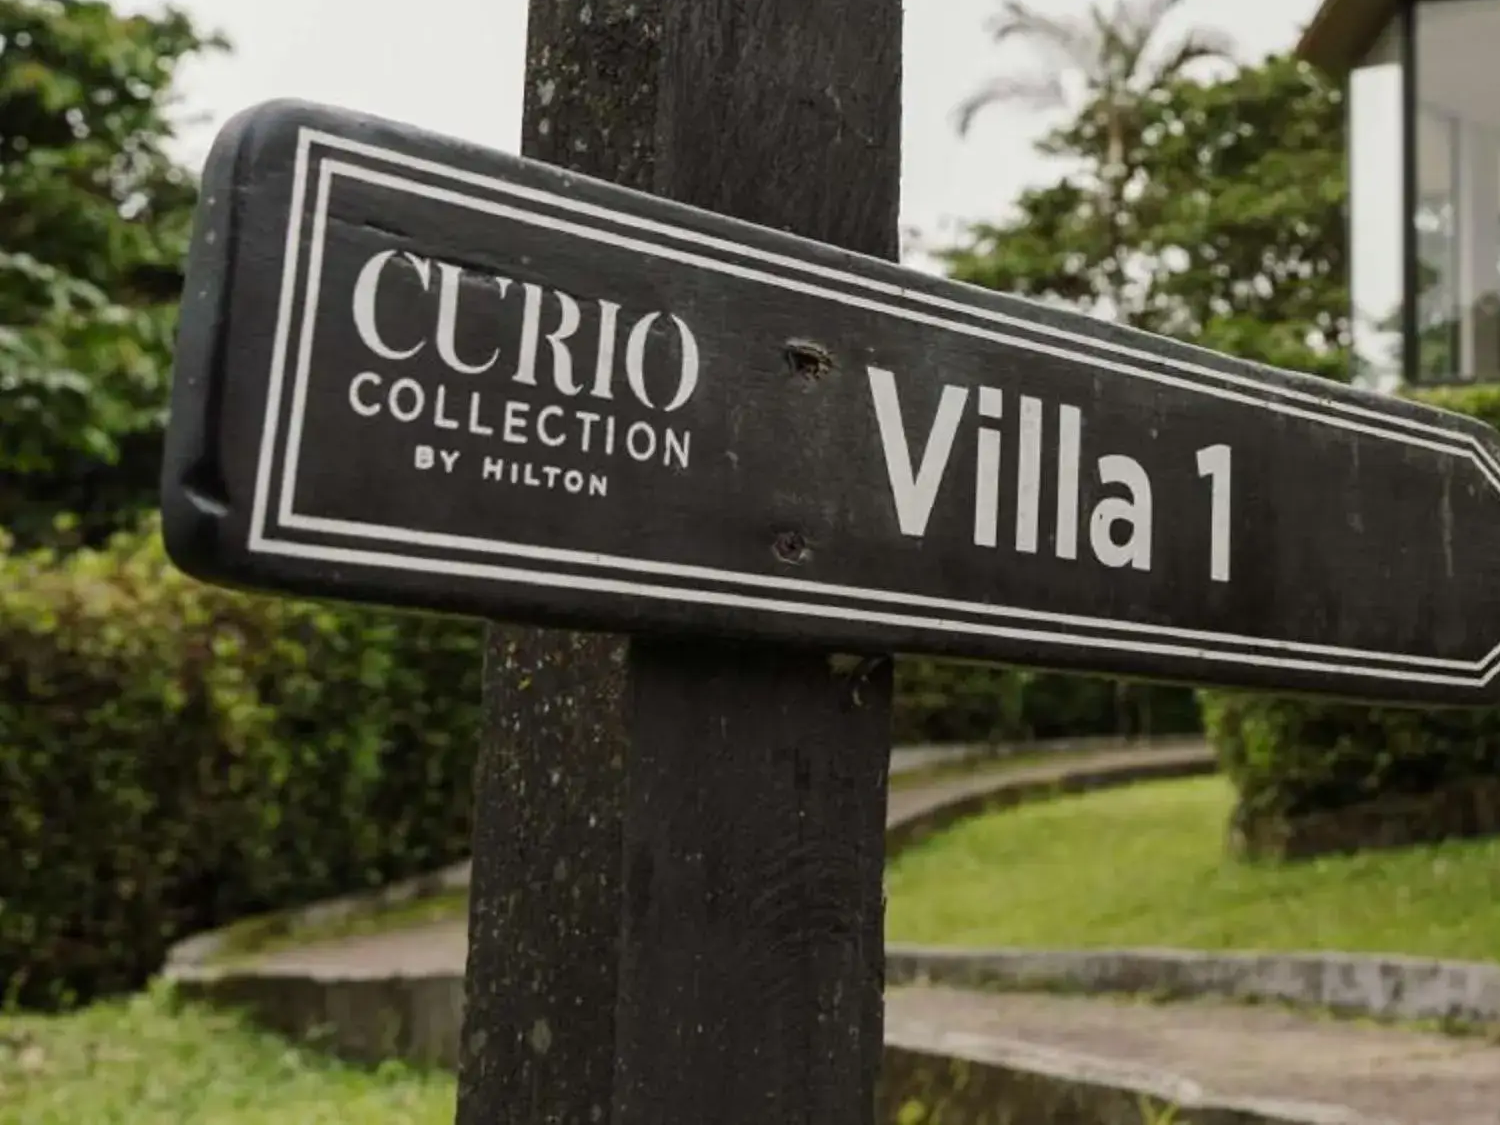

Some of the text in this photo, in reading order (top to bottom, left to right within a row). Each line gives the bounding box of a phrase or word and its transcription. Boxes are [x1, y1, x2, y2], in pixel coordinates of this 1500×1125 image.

[352, 249, 700, 412] CURIO
[348, 371, 691, 469] COLLECTION
[414, 444, 608, 497] BY HILTON
[866, 366, 1231, 582] Villa 1
